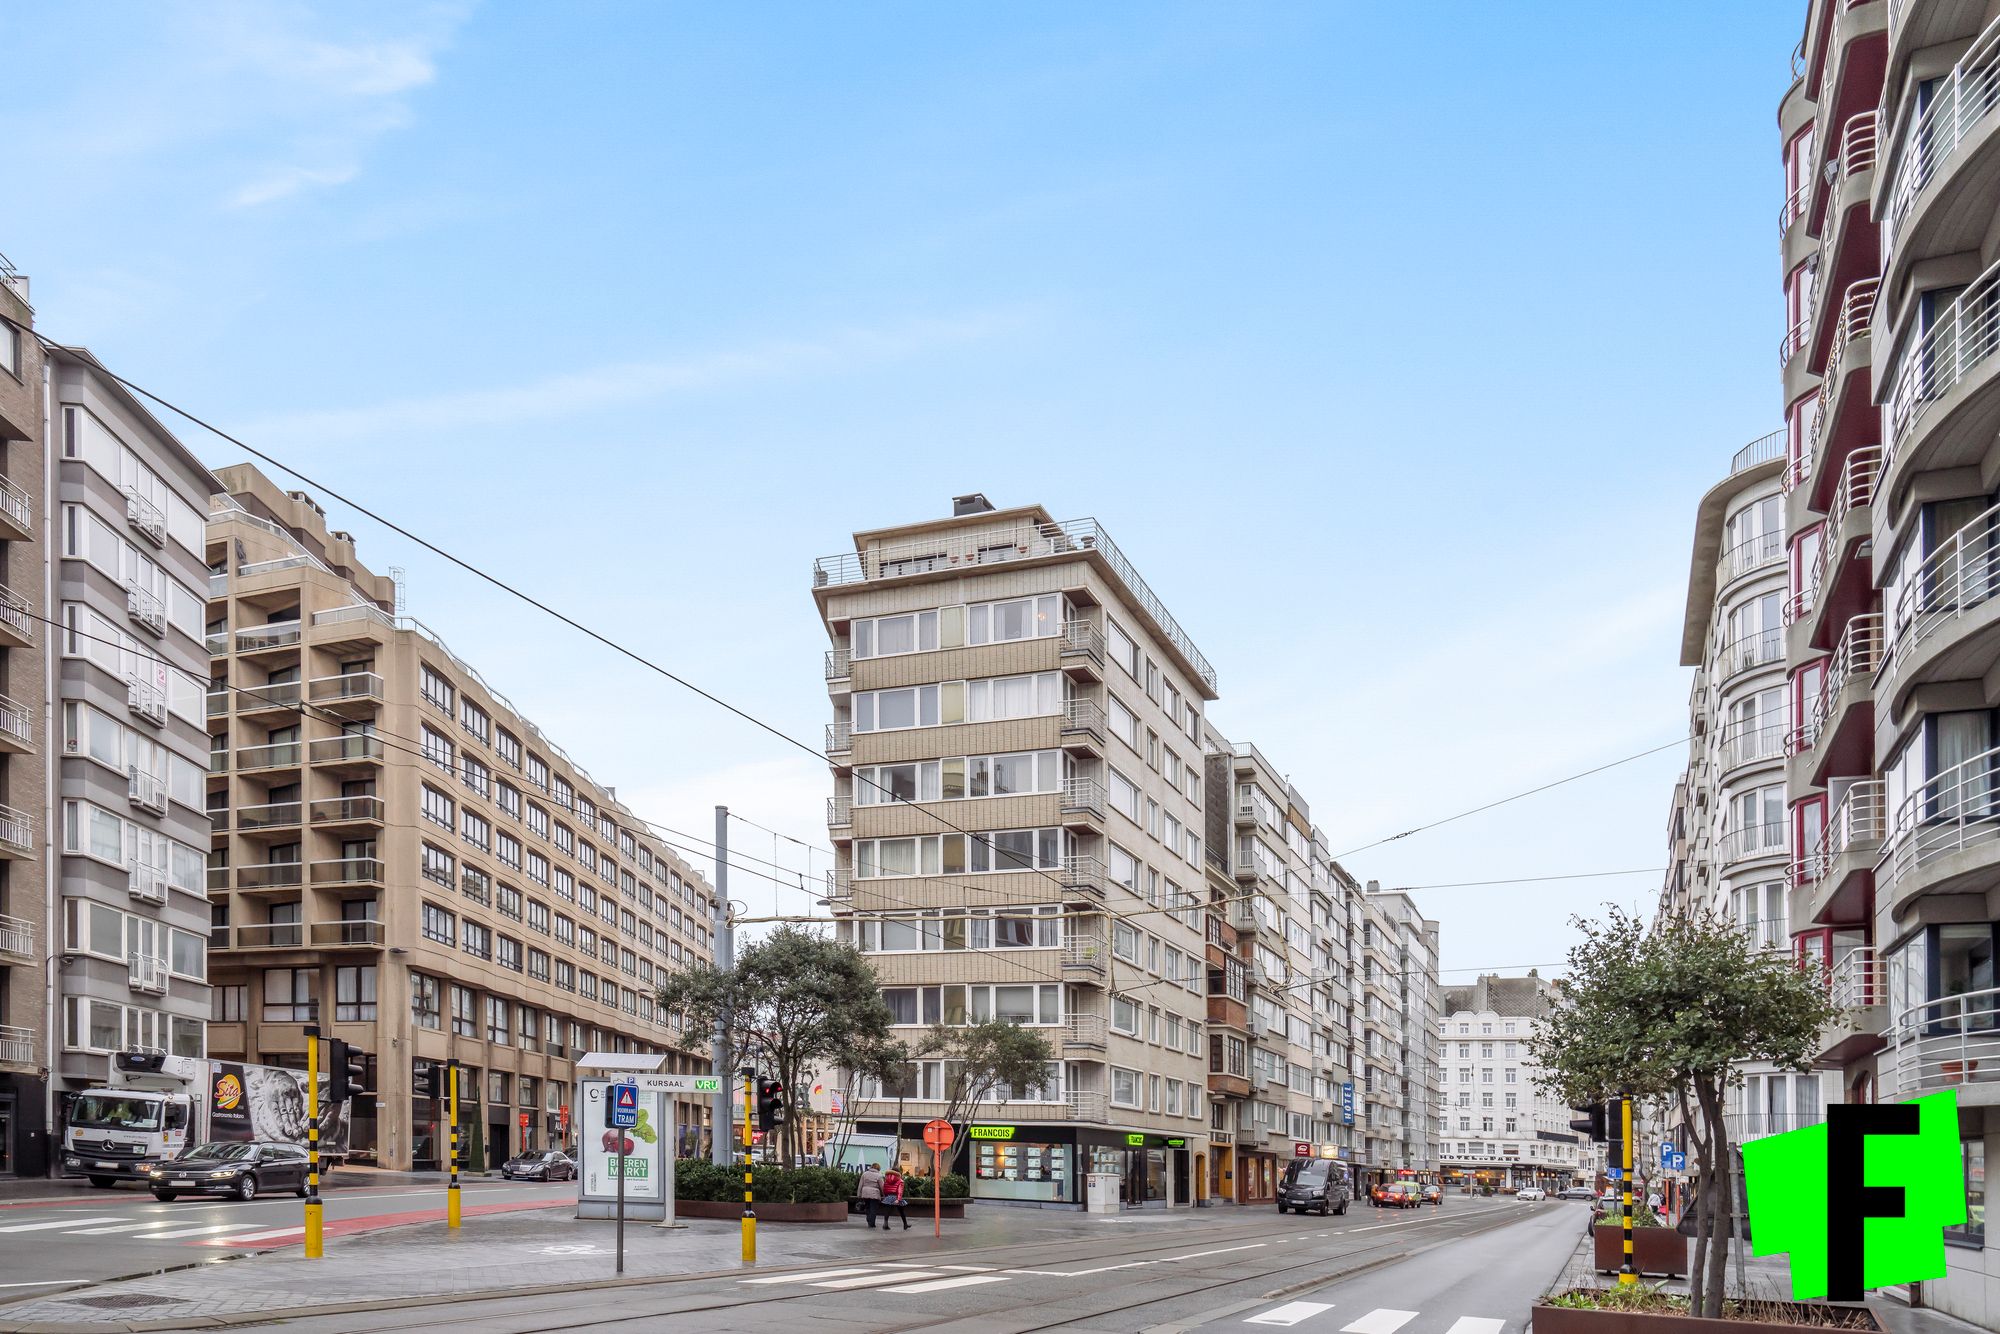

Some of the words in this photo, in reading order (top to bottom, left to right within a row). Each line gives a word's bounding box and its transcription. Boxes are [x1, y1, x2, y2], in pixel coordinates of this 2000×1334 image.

[214, 1079, 239, 1098] Sita
[1344, 1086, 1352, 1120] HOTEL
[618, 1114, 635, 1124] TRAM
[973, 1128, 1010, 1137] FRANCOIS
[1663, 1145, 1672, 1156] P
[610, 1158, 647, 1168] BEREN
[1673, 1155, 1683, 1168] P
[610, 1167, 647, 1176] MRKT
